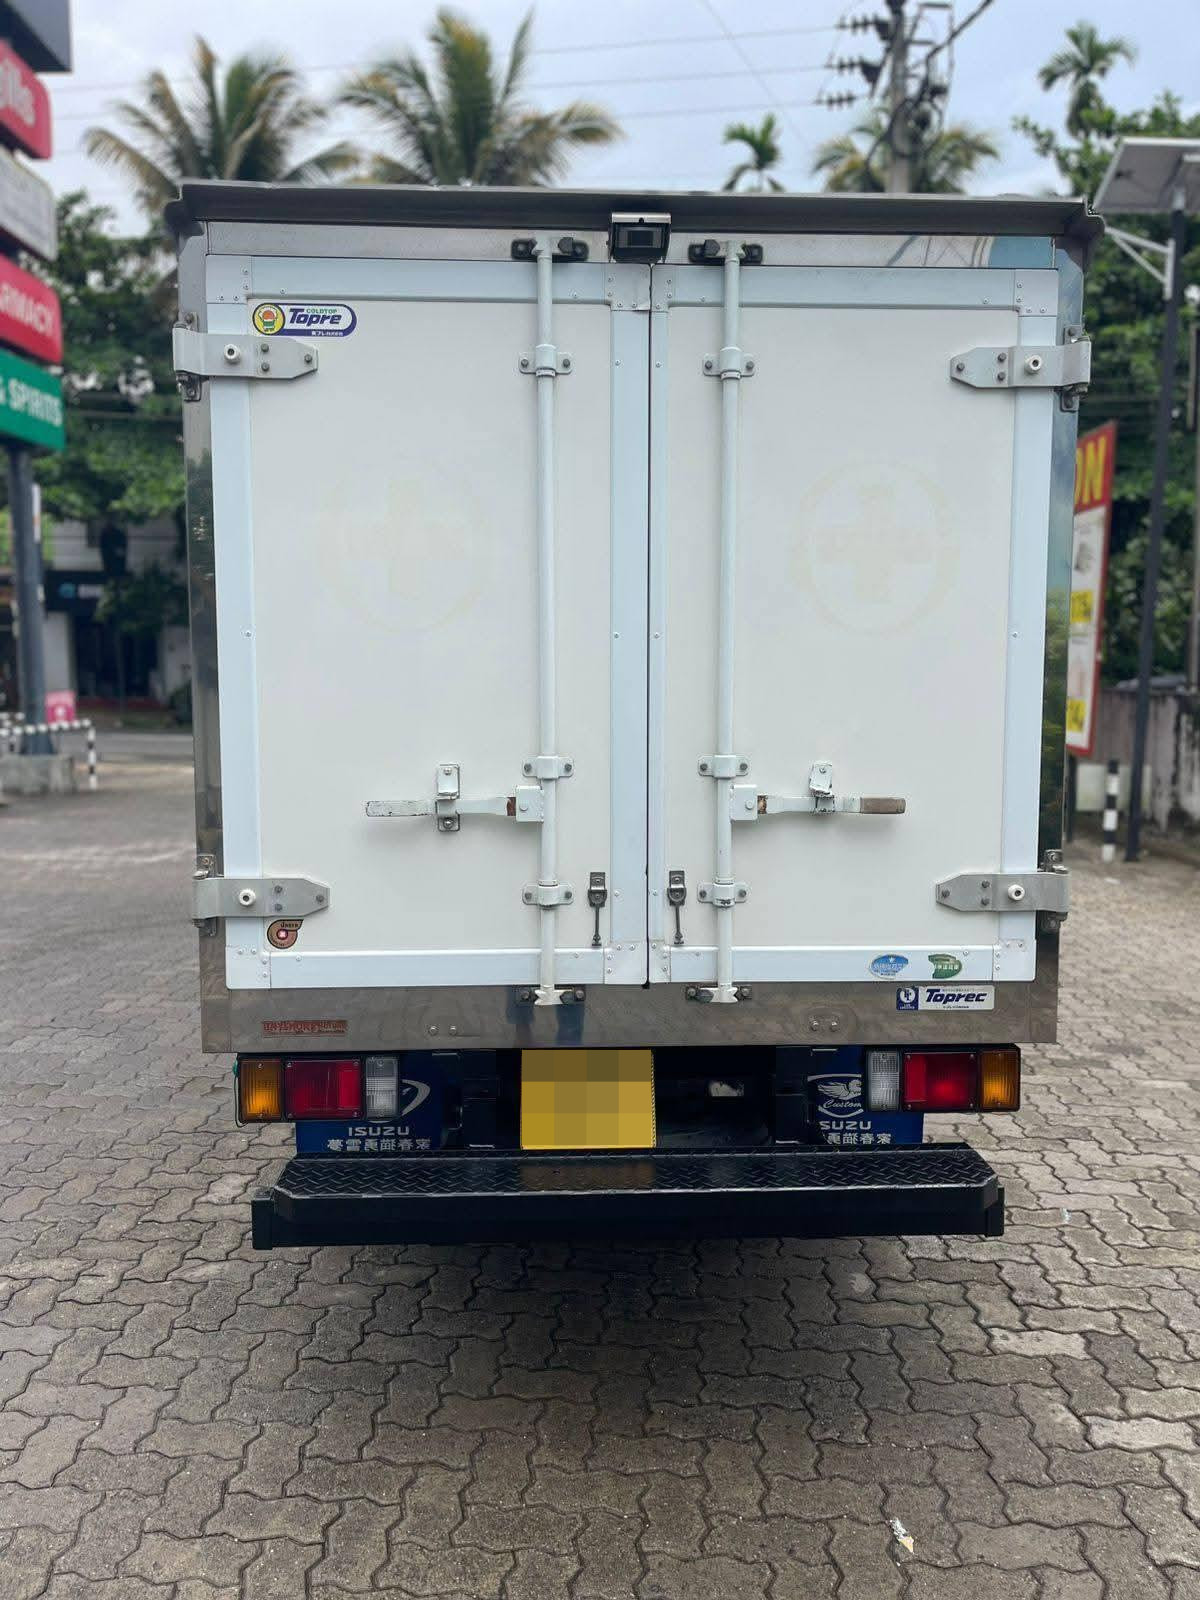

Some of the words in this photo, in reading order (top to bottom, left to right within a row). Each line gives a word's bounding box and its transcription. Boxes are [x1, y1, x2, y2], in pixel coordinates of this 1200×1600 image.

[289, 308, 342, 327] Topre
[8, 377, 63, 427] SPIRITS
[926, 988, 987, 1005] Toprec
[823, 1099, 862, 1109] Custom
[348, 1126, 410, 1137] ISUZU
